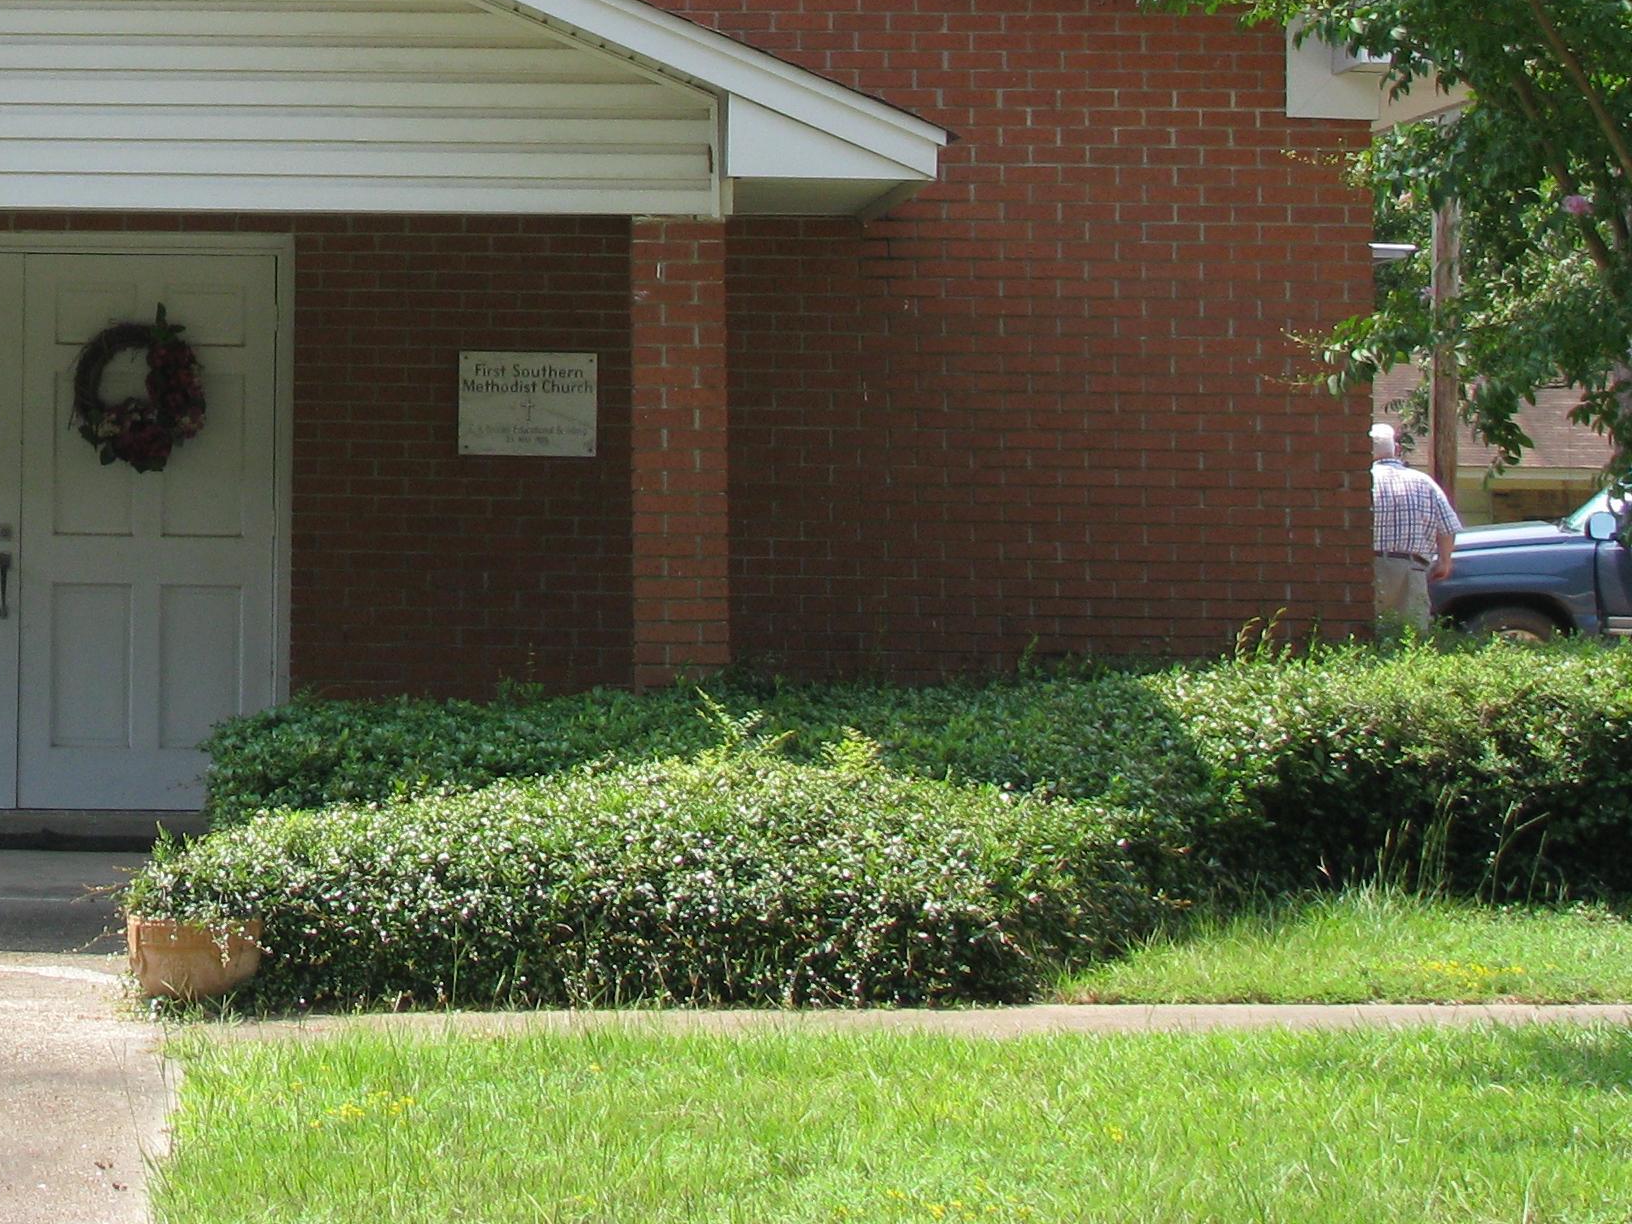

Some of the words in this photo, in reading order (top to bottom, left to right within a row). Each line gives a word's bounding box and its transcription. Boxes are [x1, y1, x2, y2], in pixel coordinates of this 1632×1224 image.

[475, 363, 506, 378] First
[513, 363, 584, 378] Southern
[463, 379, 537, 393] Methodist
[542, 379, 594, 394] Church
